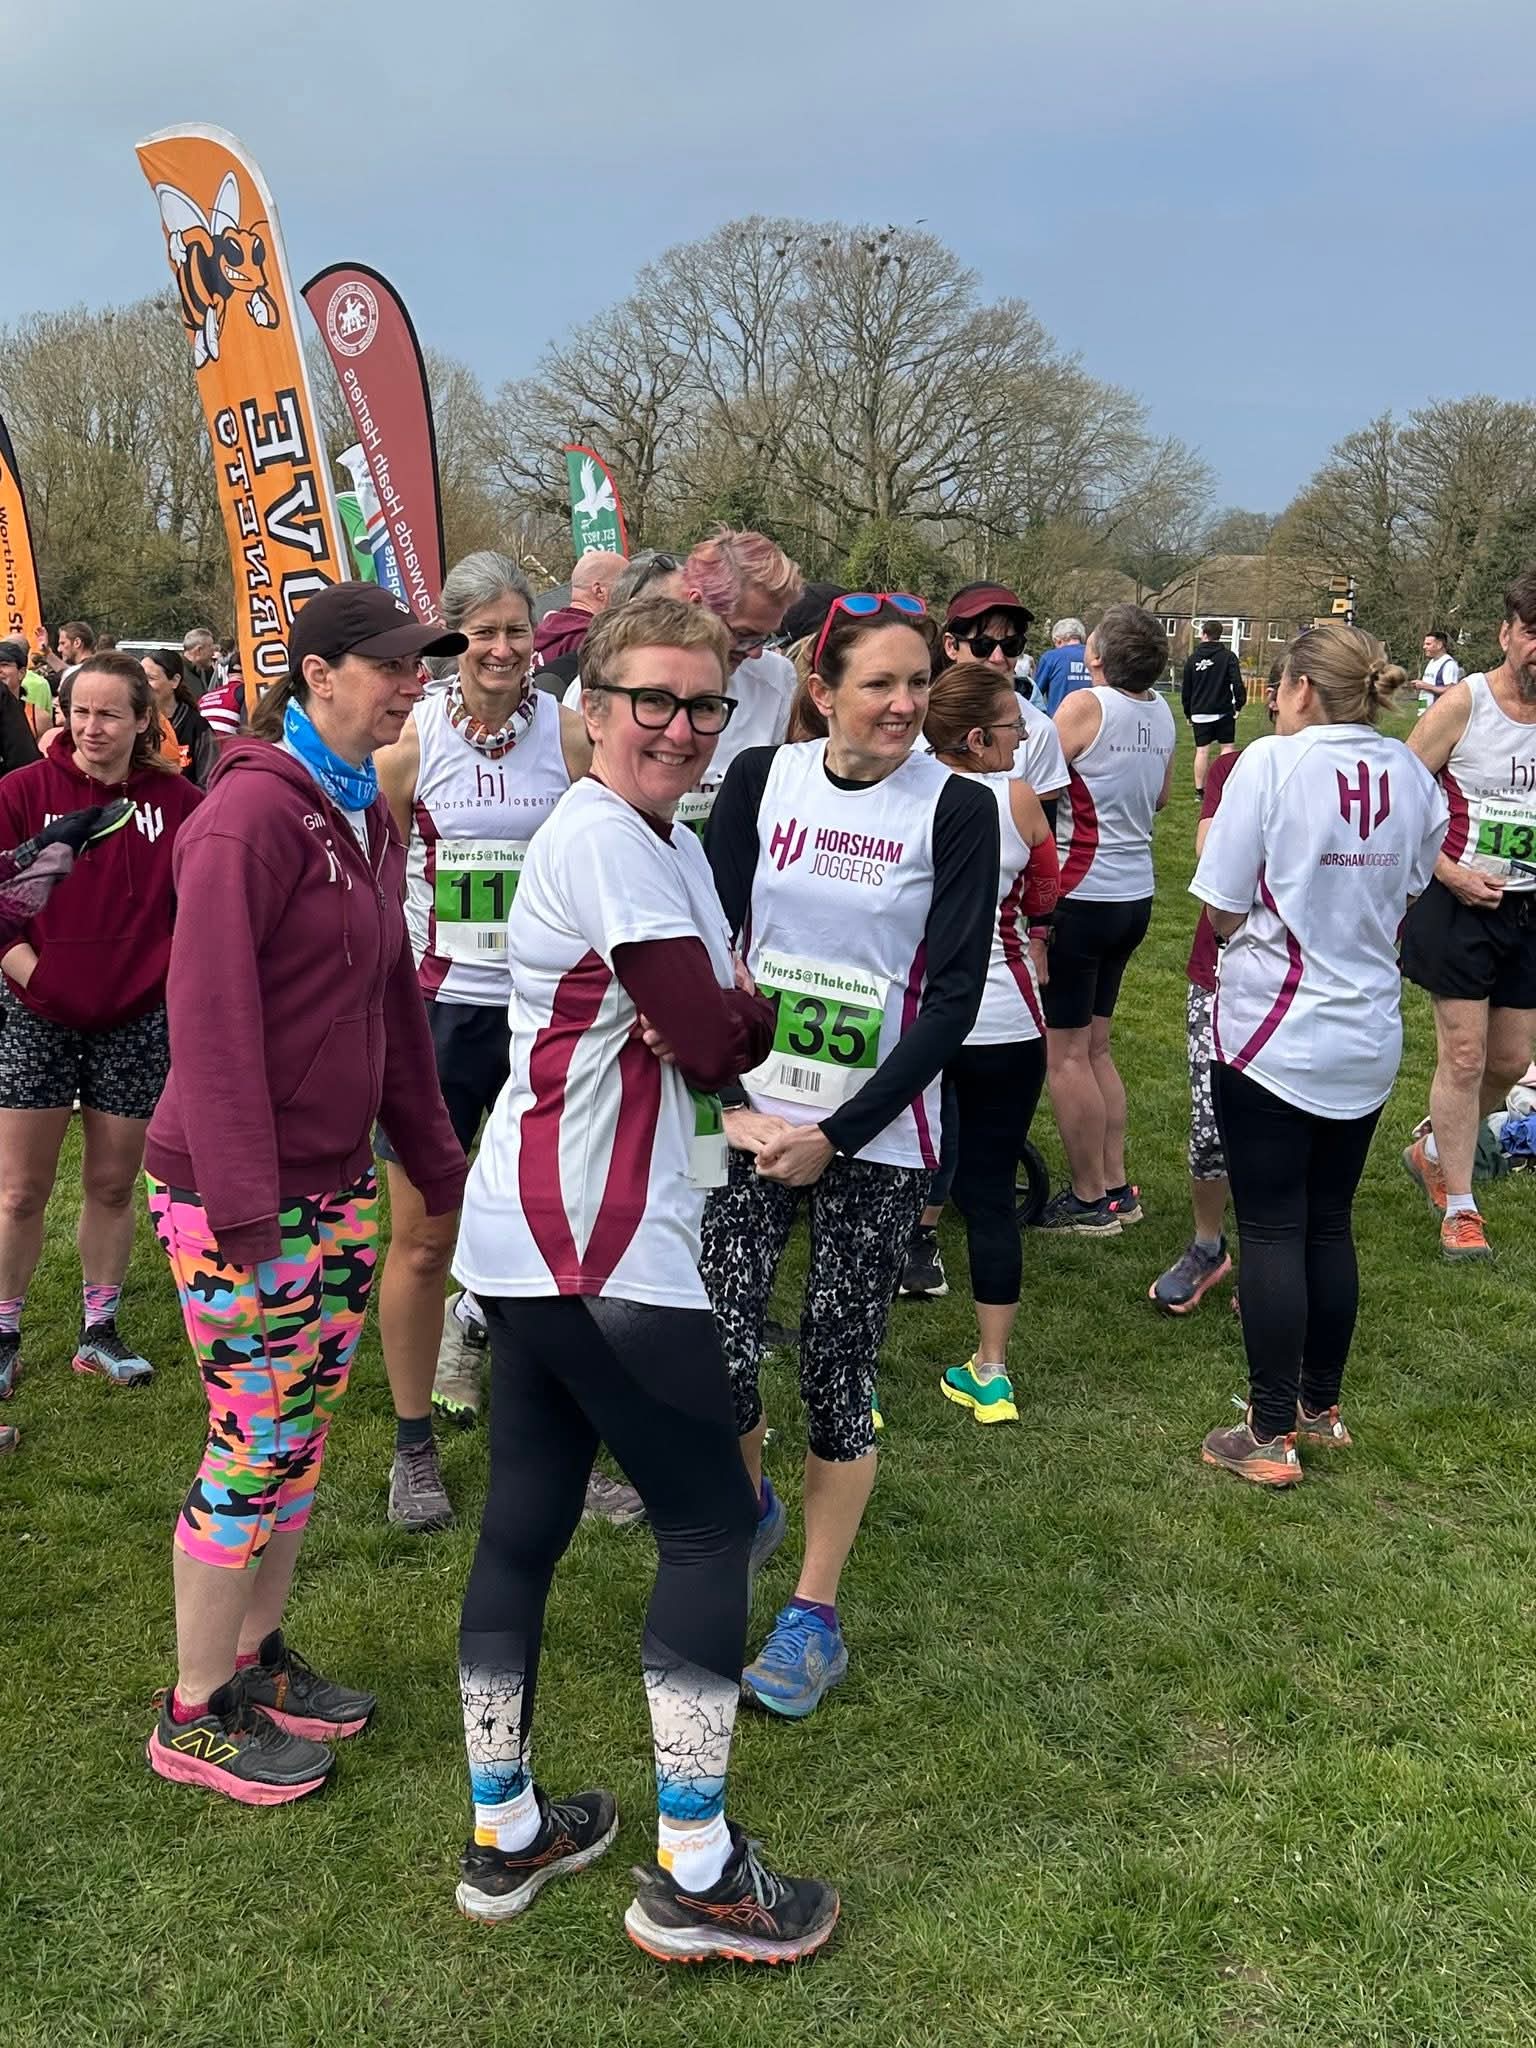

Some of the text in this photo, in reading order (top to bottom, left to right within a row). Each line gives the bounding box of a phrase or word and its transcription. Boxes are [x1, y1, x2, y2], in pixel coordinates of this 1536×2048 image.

[9, 612, 23, 634] St
[1137, 721, 1150, 749] hj
[476, 764, 505, 803] hj
[1511, 756, 1536, 792] hj
[435, 799, 492, 810] horsham
[442, 850, 525, 864] Flyers5@Thake
[814, 828, 904, 864] HORSHAM
[1488, 823, 1536, 861] 13
[809, 853, 886, 887] JOGGERS
[450, 872, 519, 921] 11
